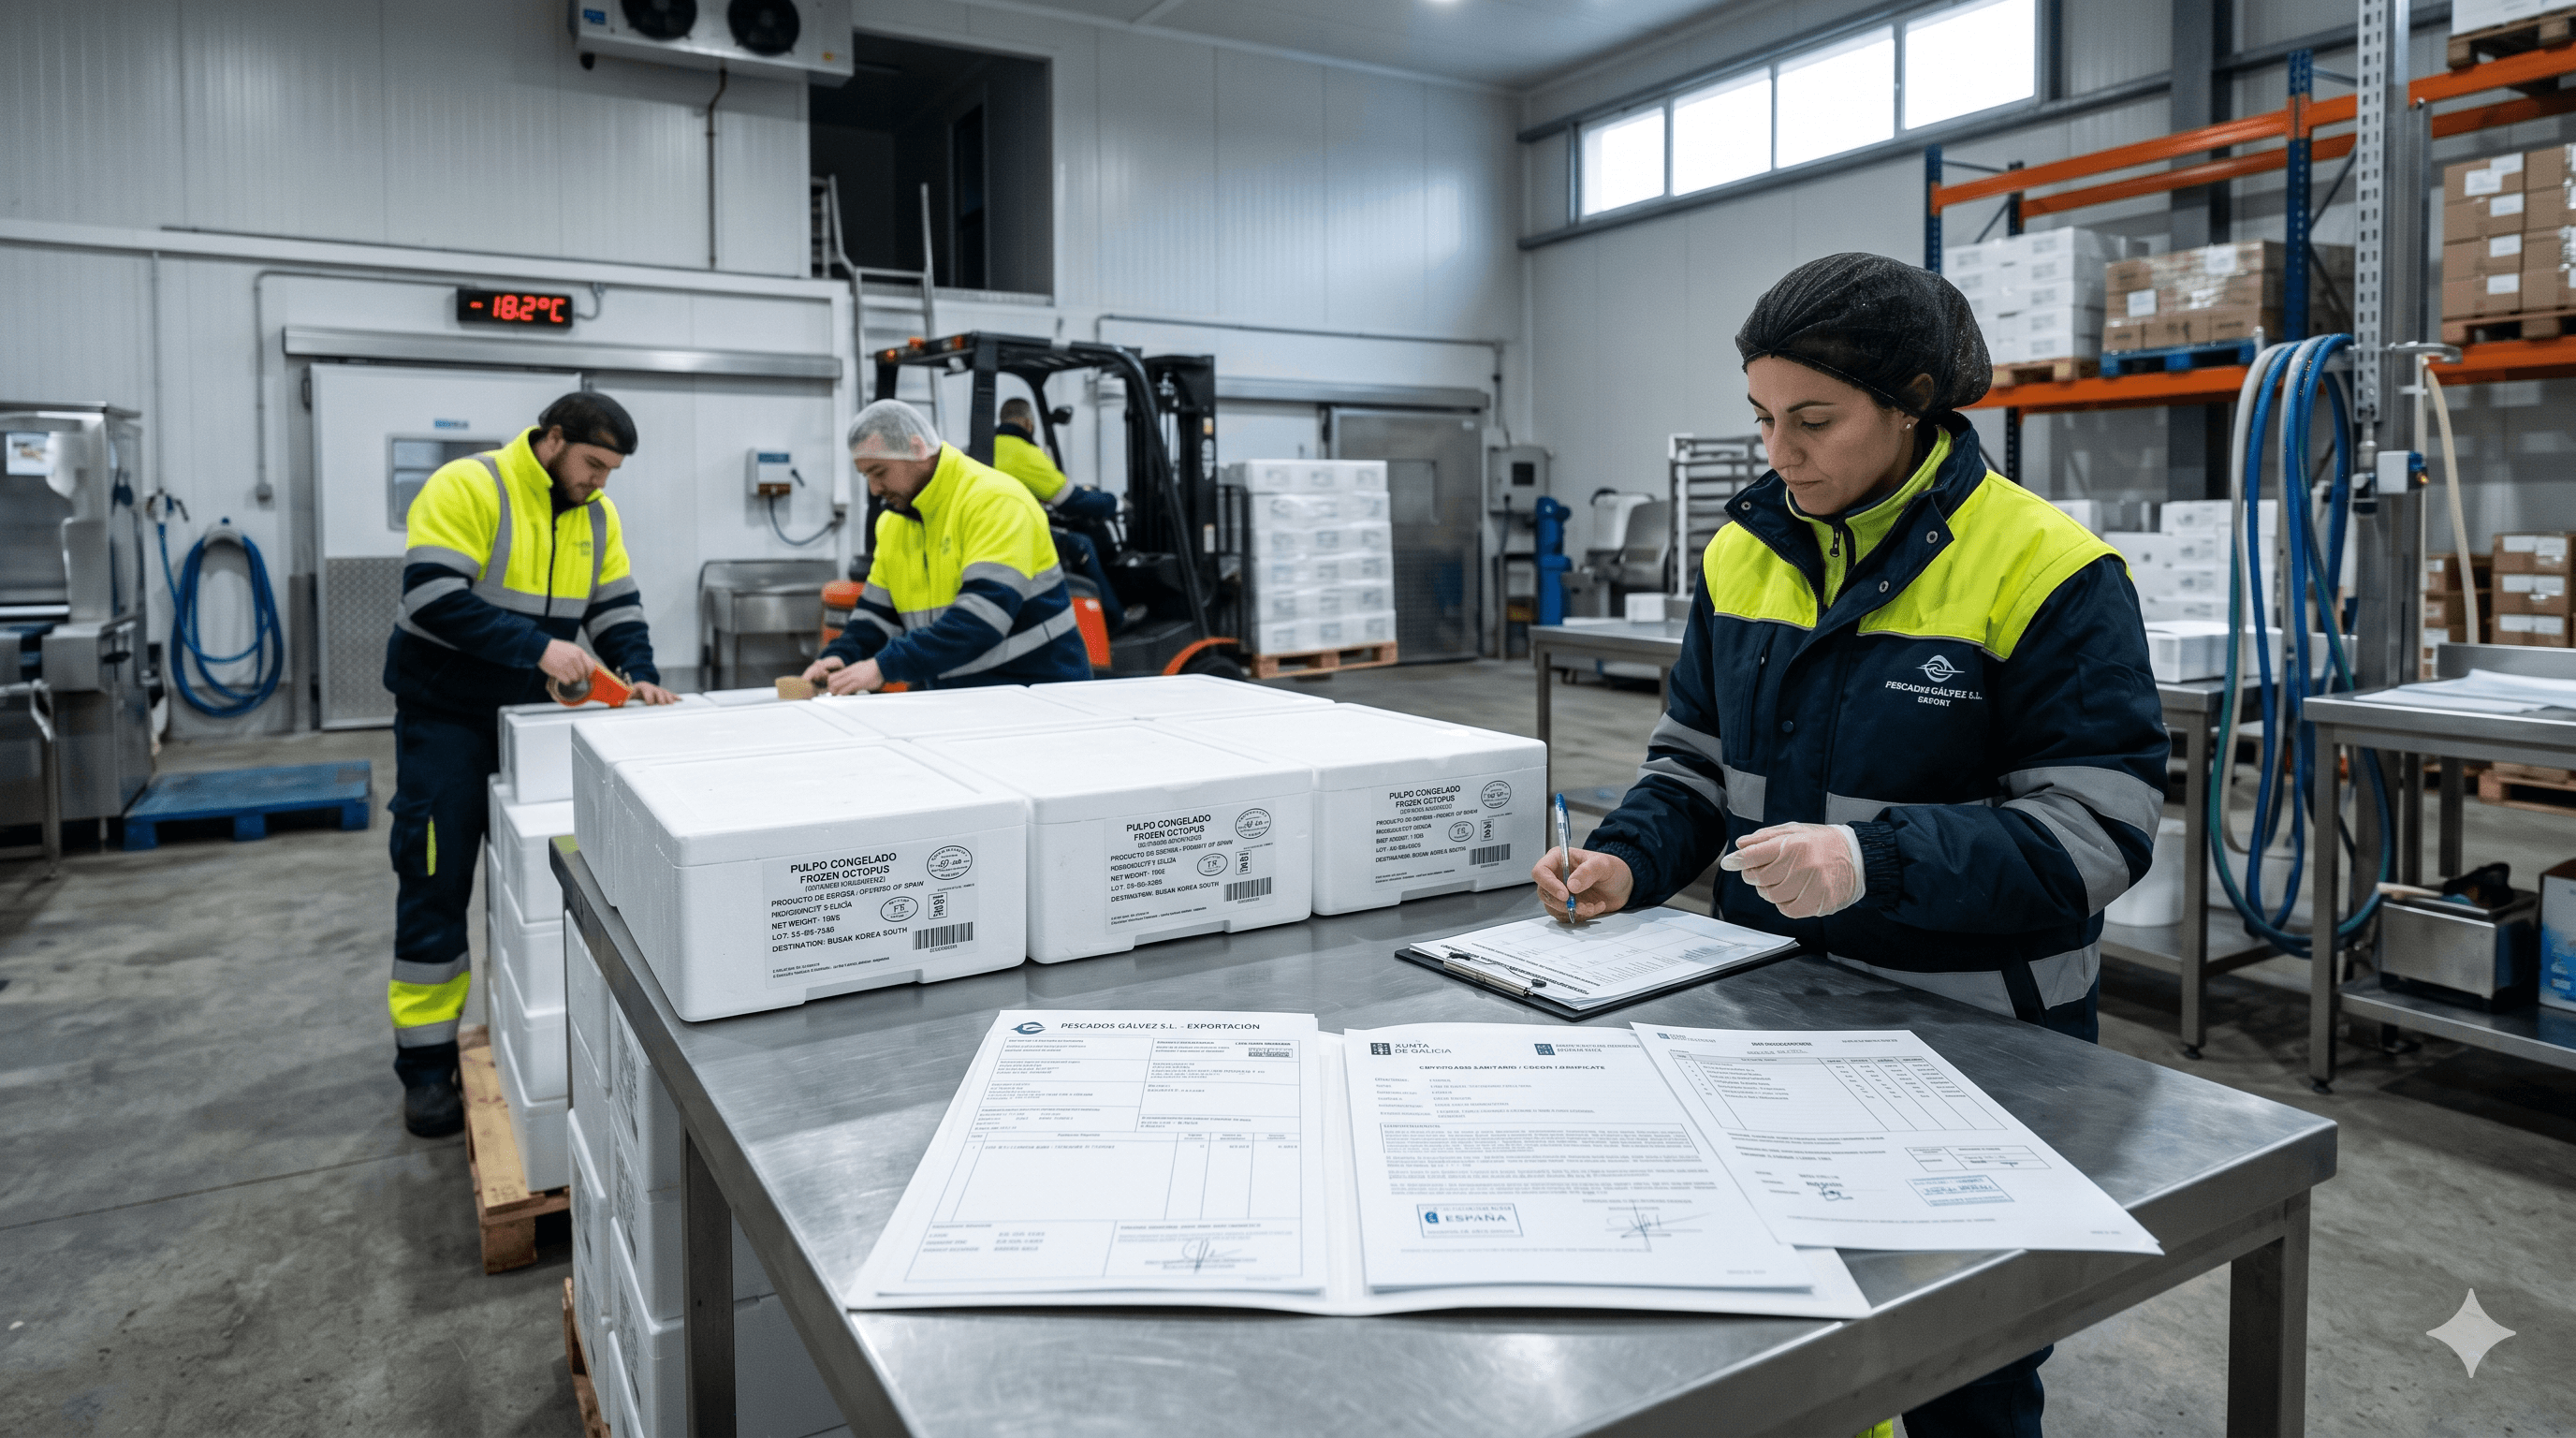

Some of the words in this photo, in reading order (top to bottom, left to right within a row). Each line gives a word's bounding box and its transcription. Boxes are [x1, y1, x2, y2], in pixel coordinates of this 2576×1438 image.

[1389, 790, 1414, 800] PULPO
[1415, 785, 1461, 797] CONGELADO
[1126, 821, 1156, 832] PULPO
[1157, 814, 1211, 828] CONGELADO
[790, 860, 827, 873] PULPO
[830, 852, 897, 869] CONGELADO
[800, 872, 840, 884] FROZEN
[842, 865, 890, 878] OCTOPUS
[814, 892, 826, 902] DE
[892, 883, 903, 891] OF
[903, 880, 925, 889] SPAIN
[1177, 884, 1198, 892] KOREA
[771, 921, 788, 931] NET
[771, 939, 826, 953] DESTINATION:
[855, 931, 882, 941] KOREA
[883, 927, 908, 936] SOUTH
